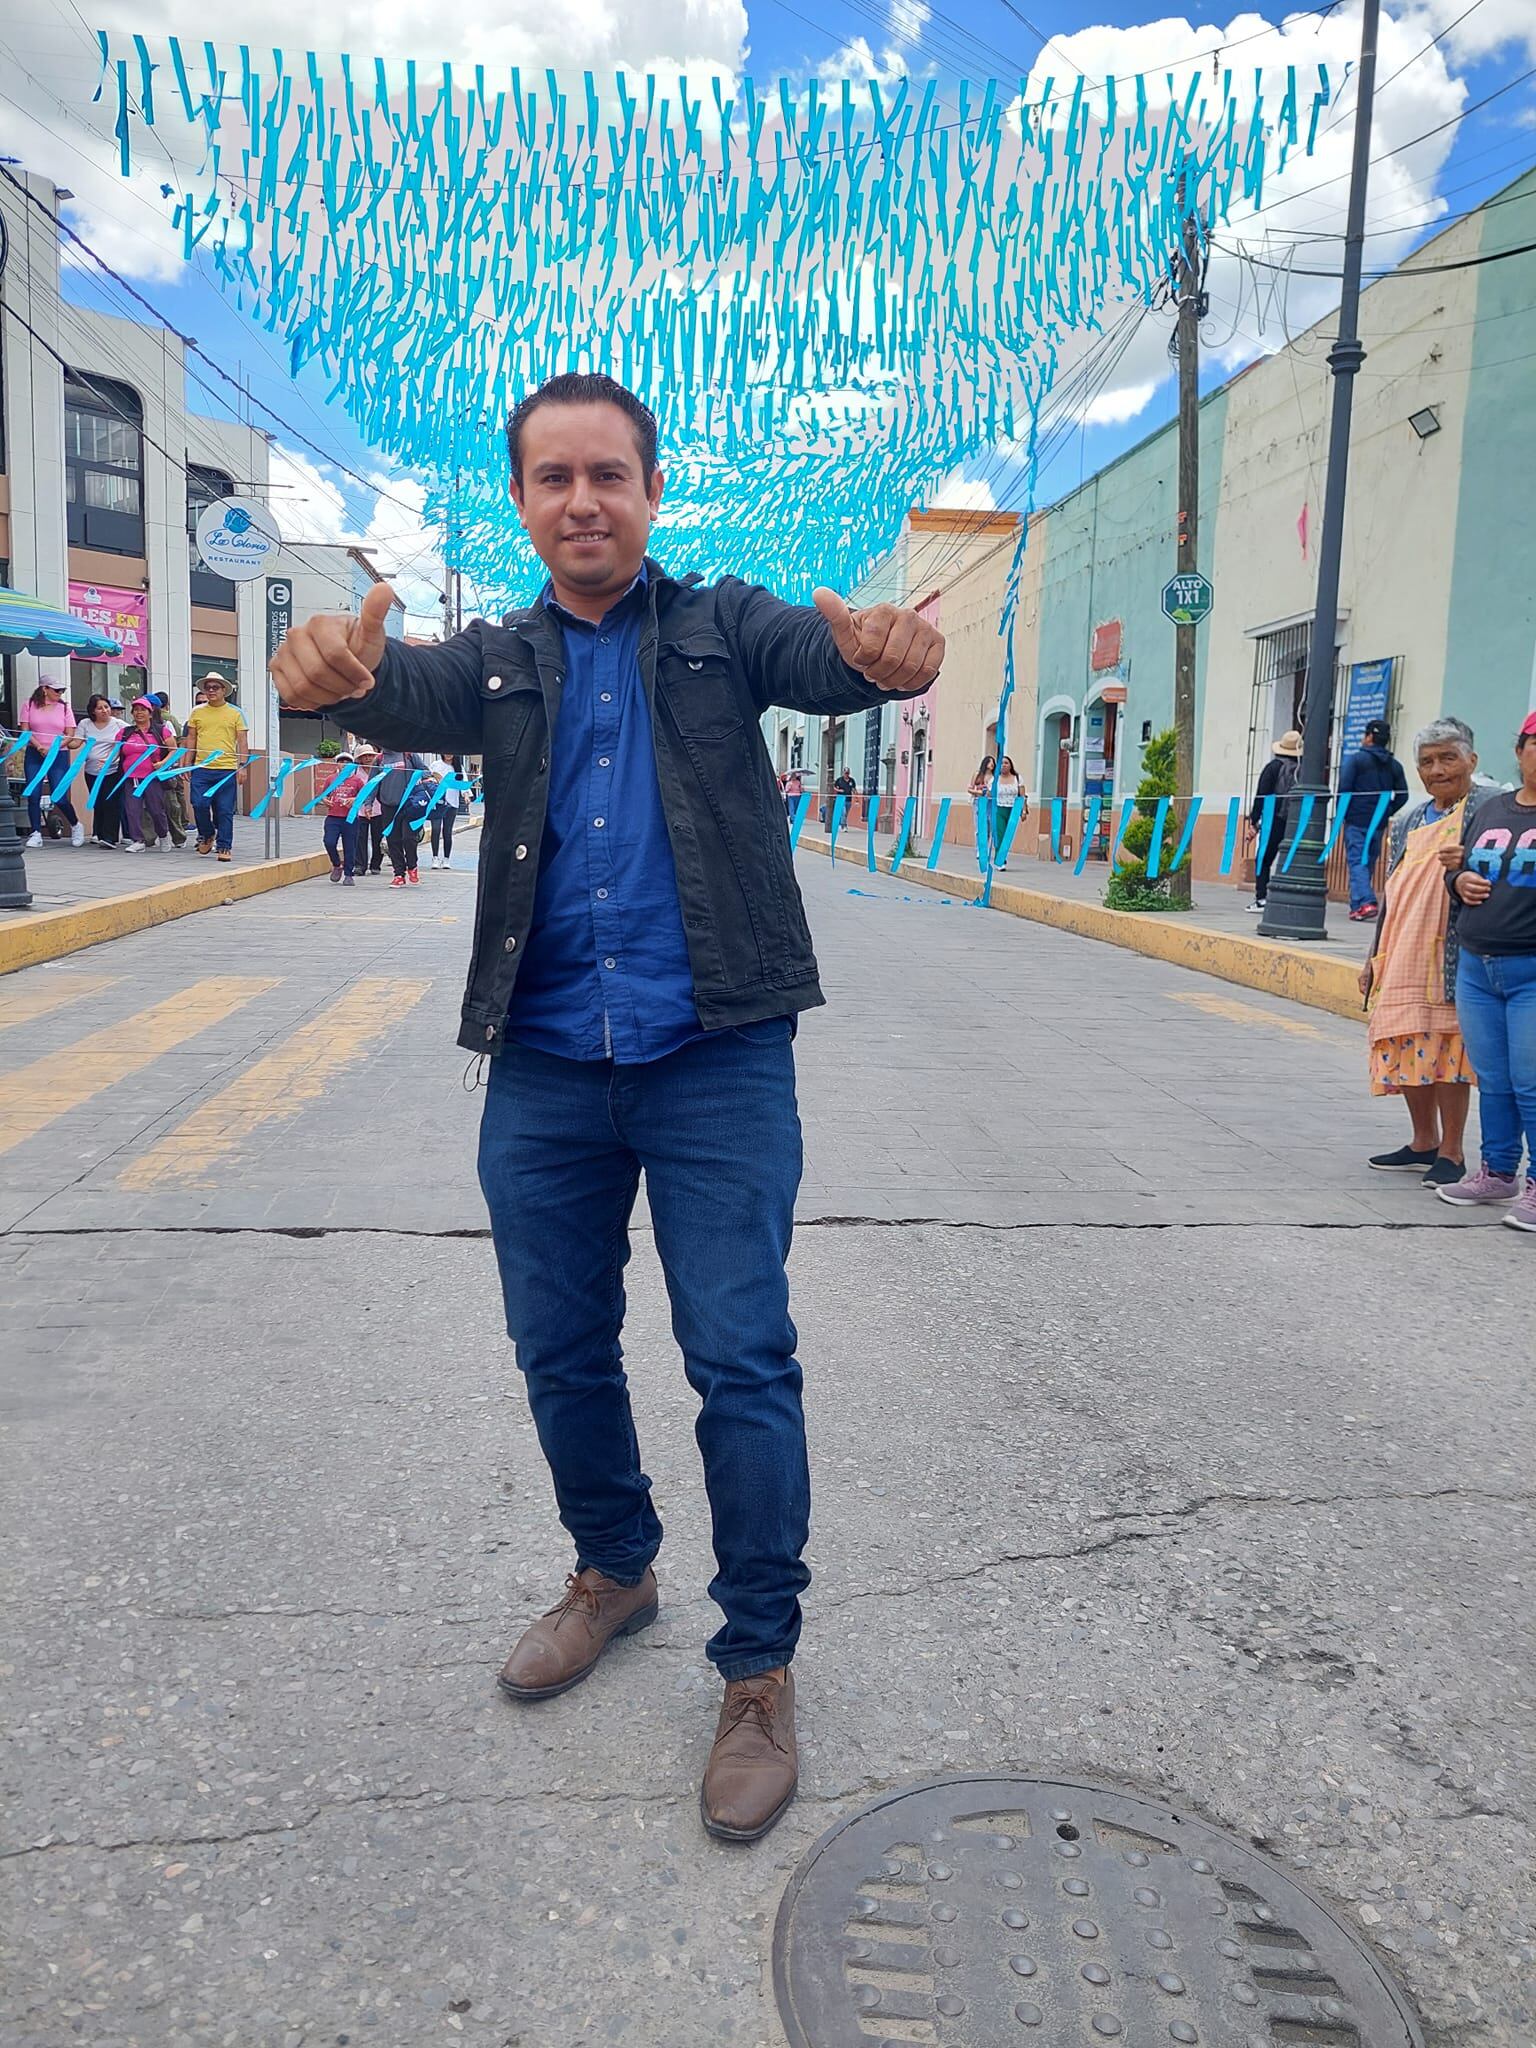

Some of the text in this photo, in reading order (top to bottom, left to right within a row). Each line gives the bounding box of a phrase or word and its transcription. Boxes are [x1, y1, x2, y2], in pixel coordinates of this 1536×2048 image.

[209, 532, 267, 551] La Gloria
[208, 556, 261, 566] RESTAURANT
[1172, 580, 1203, 590] ALTO
[1176, 590, 1199, 605] 1X1
[69, 606, 140, 628] ILES EN
[95, 625, 140, 647] ADA
[279, 611, 288, 646] UALES
